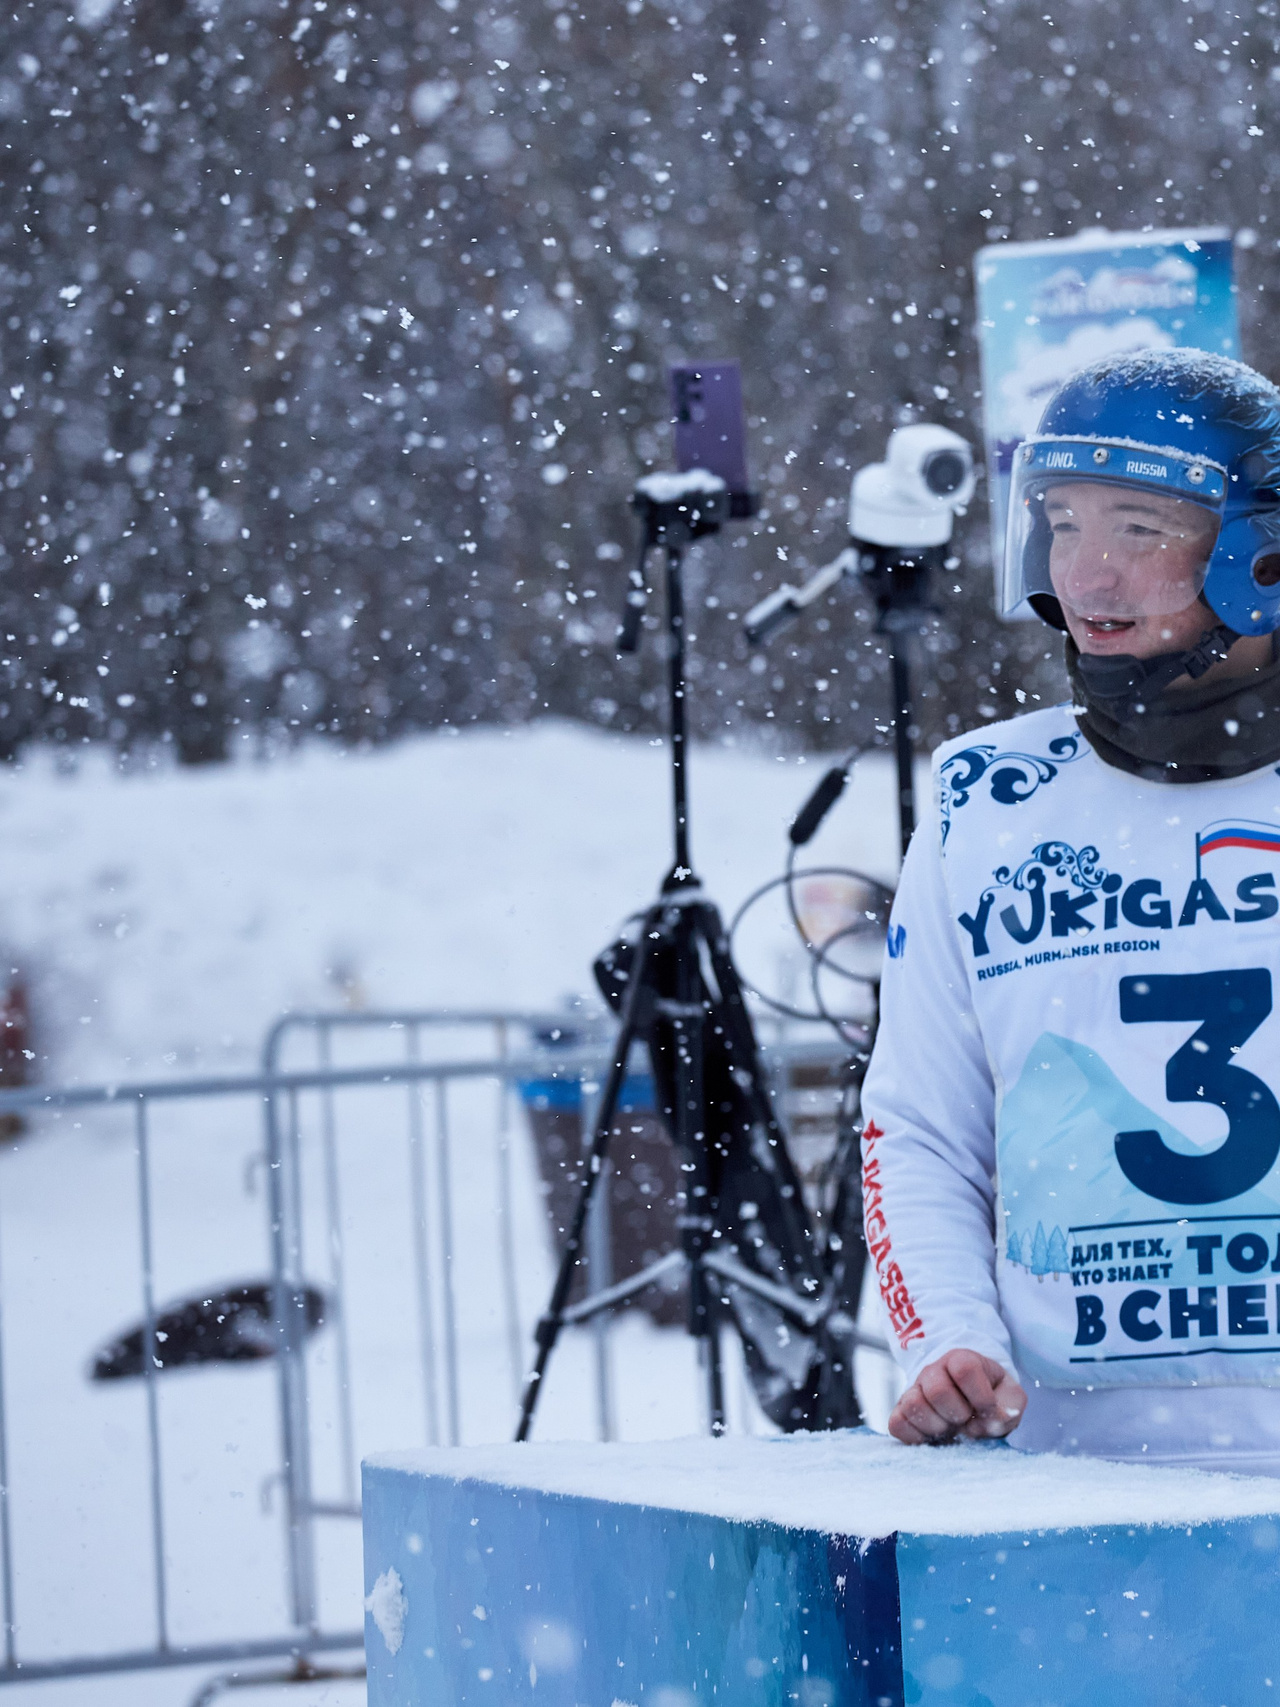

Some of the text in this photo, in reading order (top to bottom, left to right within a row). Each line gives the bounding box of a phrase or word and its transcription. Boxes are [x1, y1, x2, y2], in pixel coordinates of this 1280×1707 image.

[1126, 460, 1168, 478] RUSSIA
[977, 959, 1022, 981] RUSSIA,
[1103, 939, 1160, 954] REGION
[1070, 1237, 1172, 1267] ДЛЯ ТЕХ,
[1071, 1263, 1173, 1287] КТО ЗНАЕТ
[1074, 1294, 1107, 1346] В
